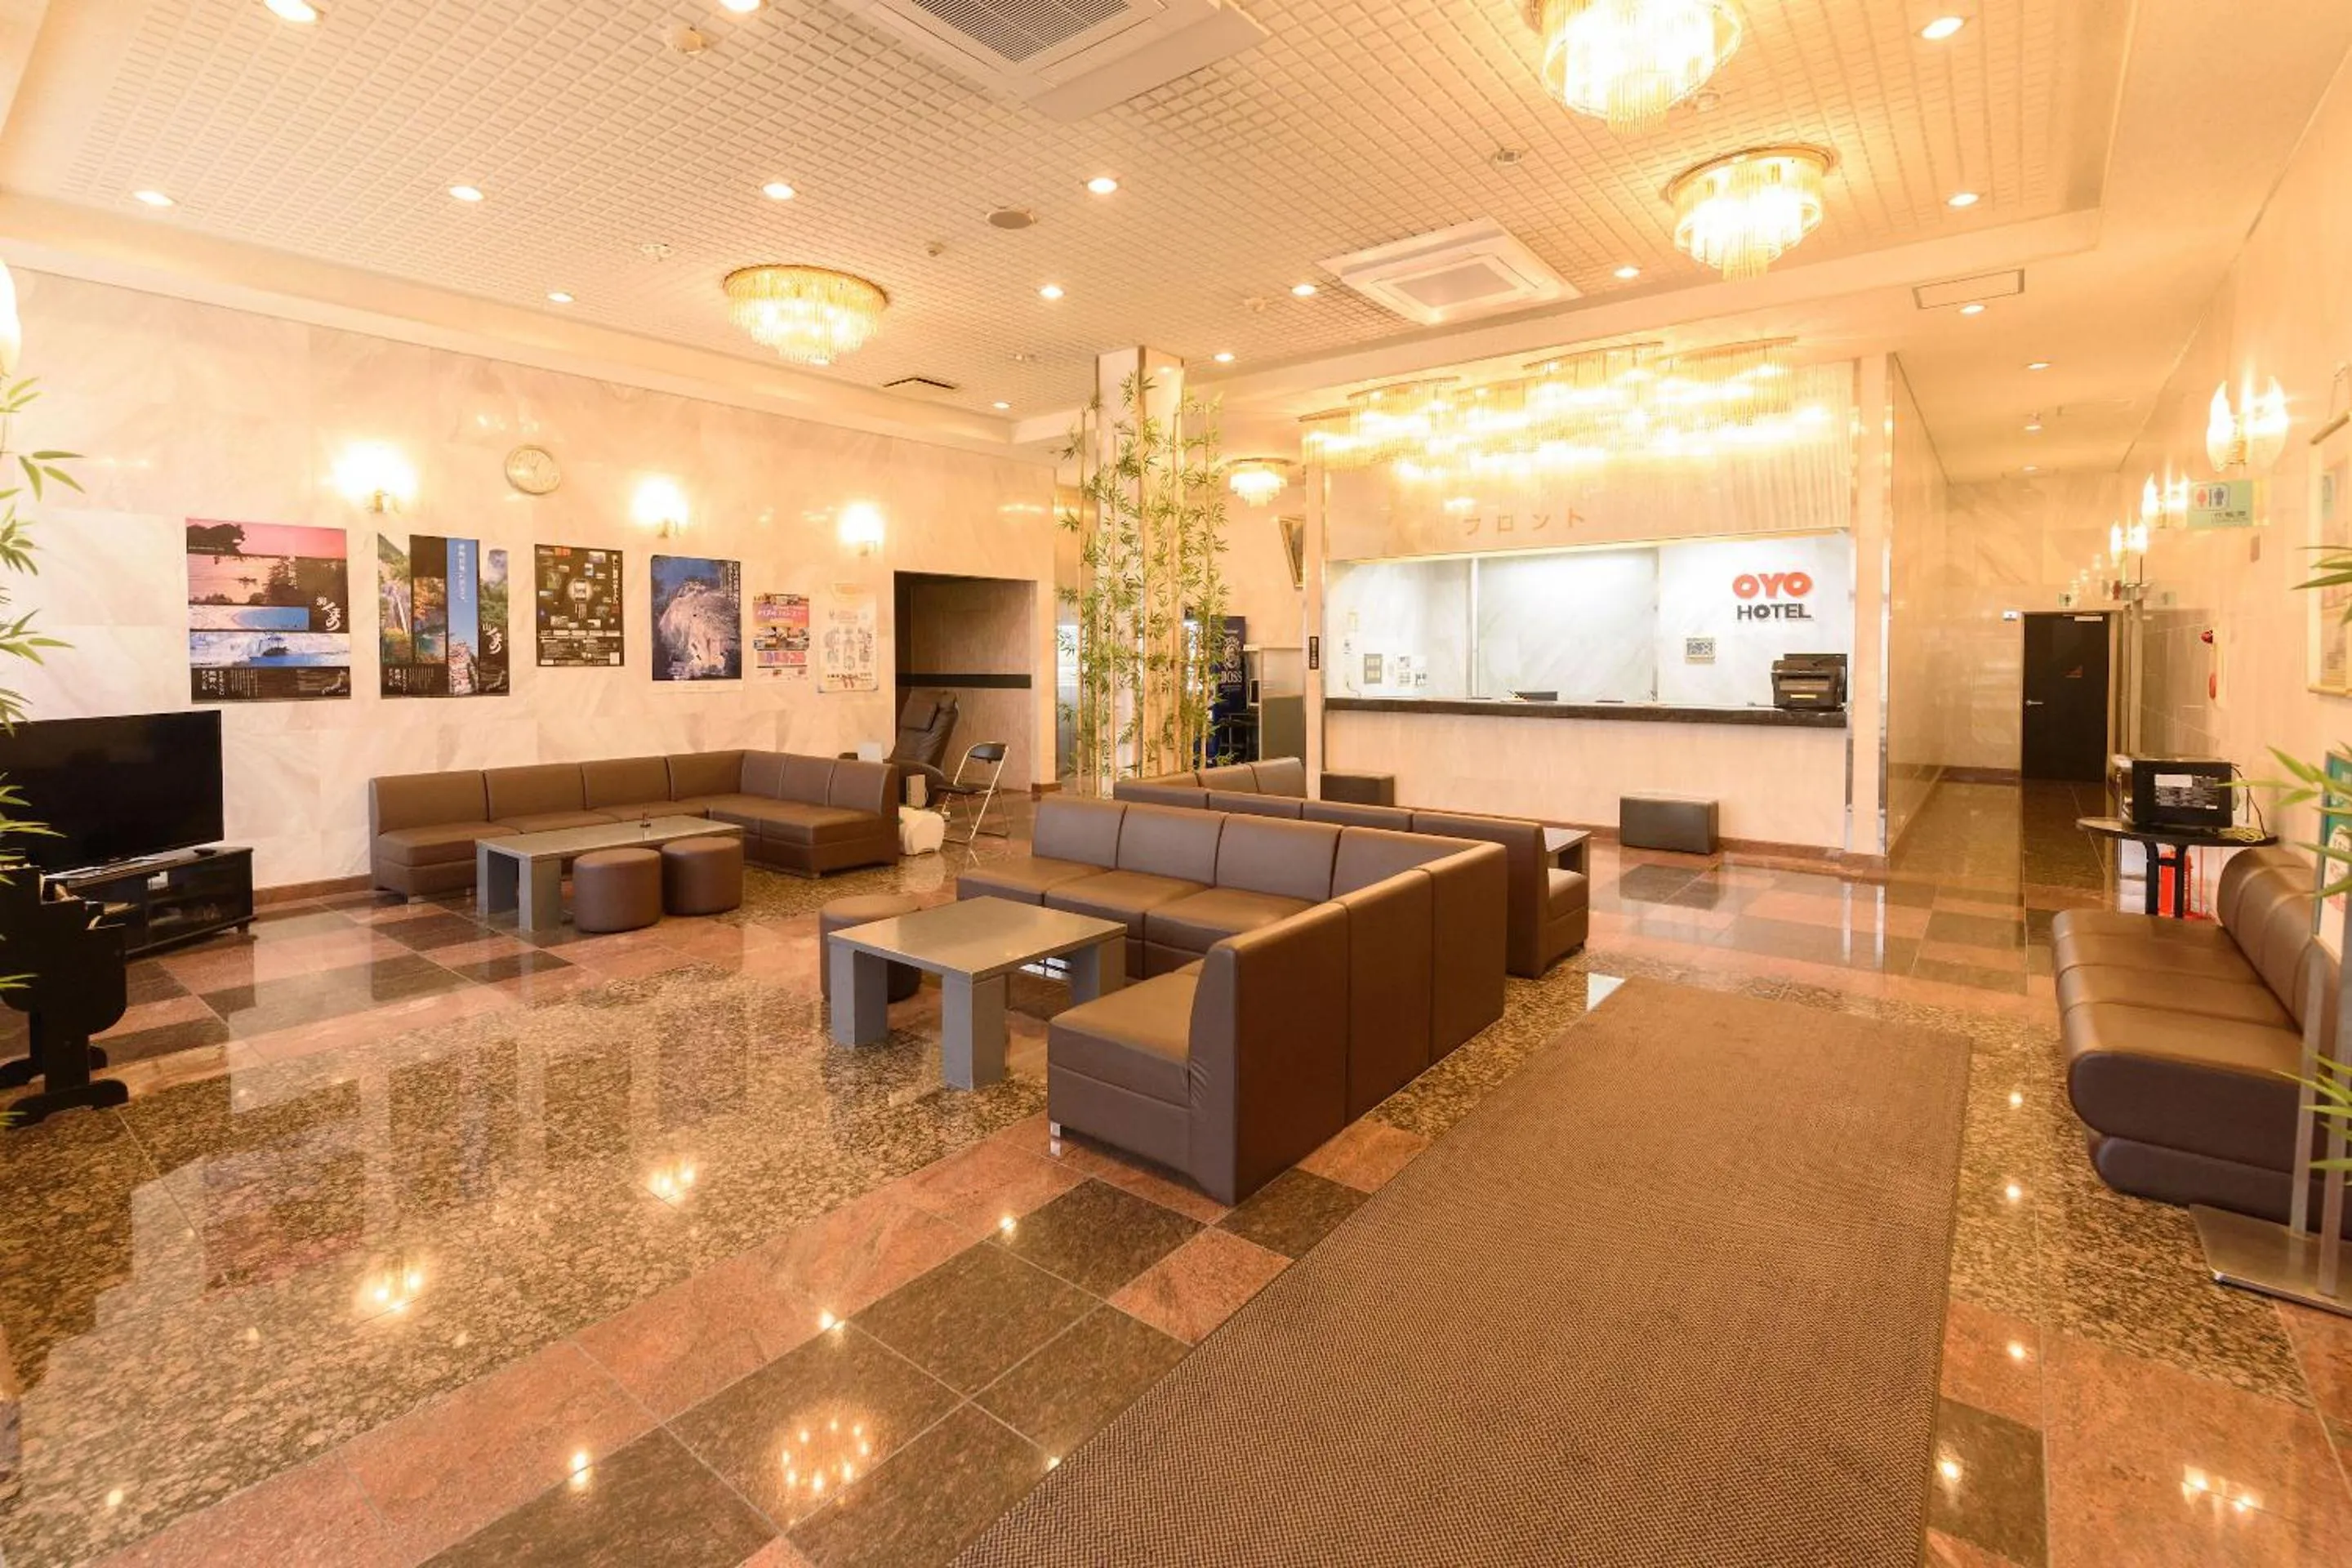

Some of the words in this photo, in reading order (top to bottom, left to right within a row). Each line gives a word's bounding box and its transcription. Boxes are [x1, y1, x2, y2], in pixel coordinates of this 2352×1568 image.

[1463, 508, 1584, 536] フロント
[1733, 572, 1812, 599] OYO
[1737, 604, 1811, 620] HOTEL
